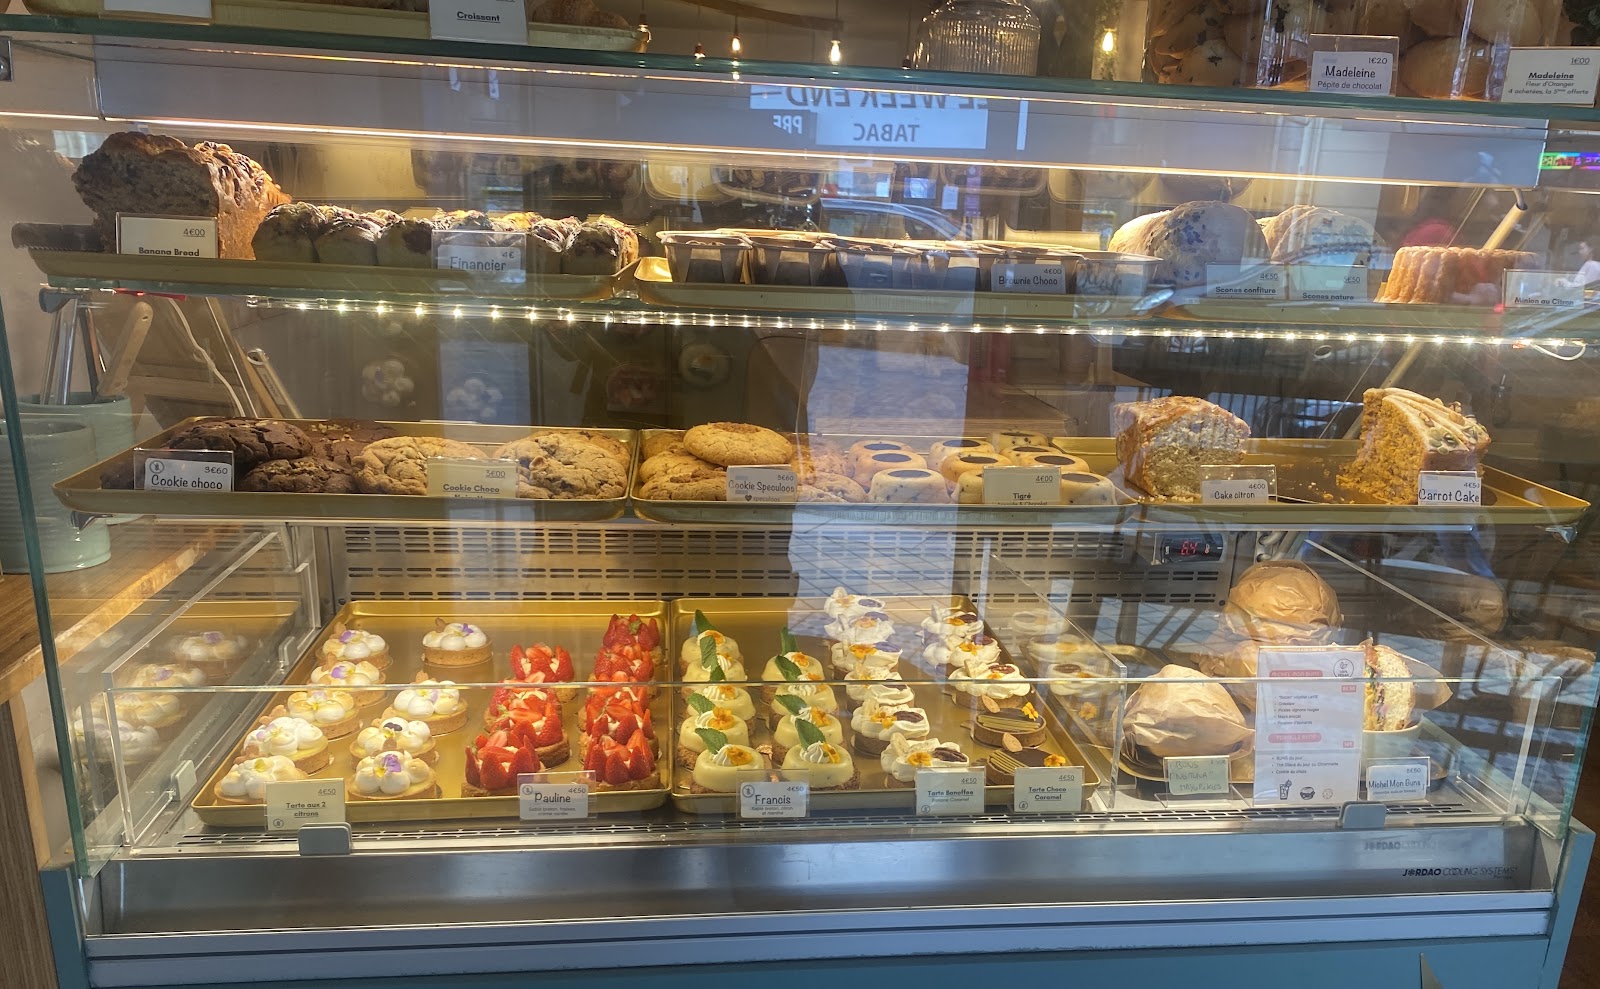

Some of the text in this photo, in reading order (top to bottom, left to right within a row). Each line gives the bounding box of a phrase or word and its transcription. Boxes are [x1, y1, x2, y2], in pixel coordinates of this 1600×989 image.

[456, 11, 501, 22] Croissant
[1368, 57, 1388, 65] 1€20
[1571, 57, 1591, 65] 1€00
[1325, 65, 1376, 78] Madeleine
[1317, 80, 1340, 90] Pépite
[1352, 82, 1382, 90] chocolat
[183, 228, 206, 236] 4€00
[138, 247, 200, 257] Banana Bread
[450, 256, 507, 271] Financier
[998, 275, 1058, 286] Brownie Choco
[1215, 286, 1277, 294] Scones confiture
[1302, 292, 1329, 300] Scones
[1551, 298, 1574, 306] Citron
[204, 466, 228, 475] 3€60
[151, 474, 223, 490] Cookie choco
[728, 480, 795, 493] Cookie Speculoos
[443, 483, 500, 493] Cookie Choco
[1013, 492, 1032, 501] Tigré
[1214, 490, 1255, 500] Cake citron
[1418, 488, 1480, 503] Carrot Cake
[1368, 780, 1389, 788] Michel
[1389, 779, 1404, 788] Mon
[534, 792, 571, 803] Pauline
[755, 794, 791, 805] Francis
